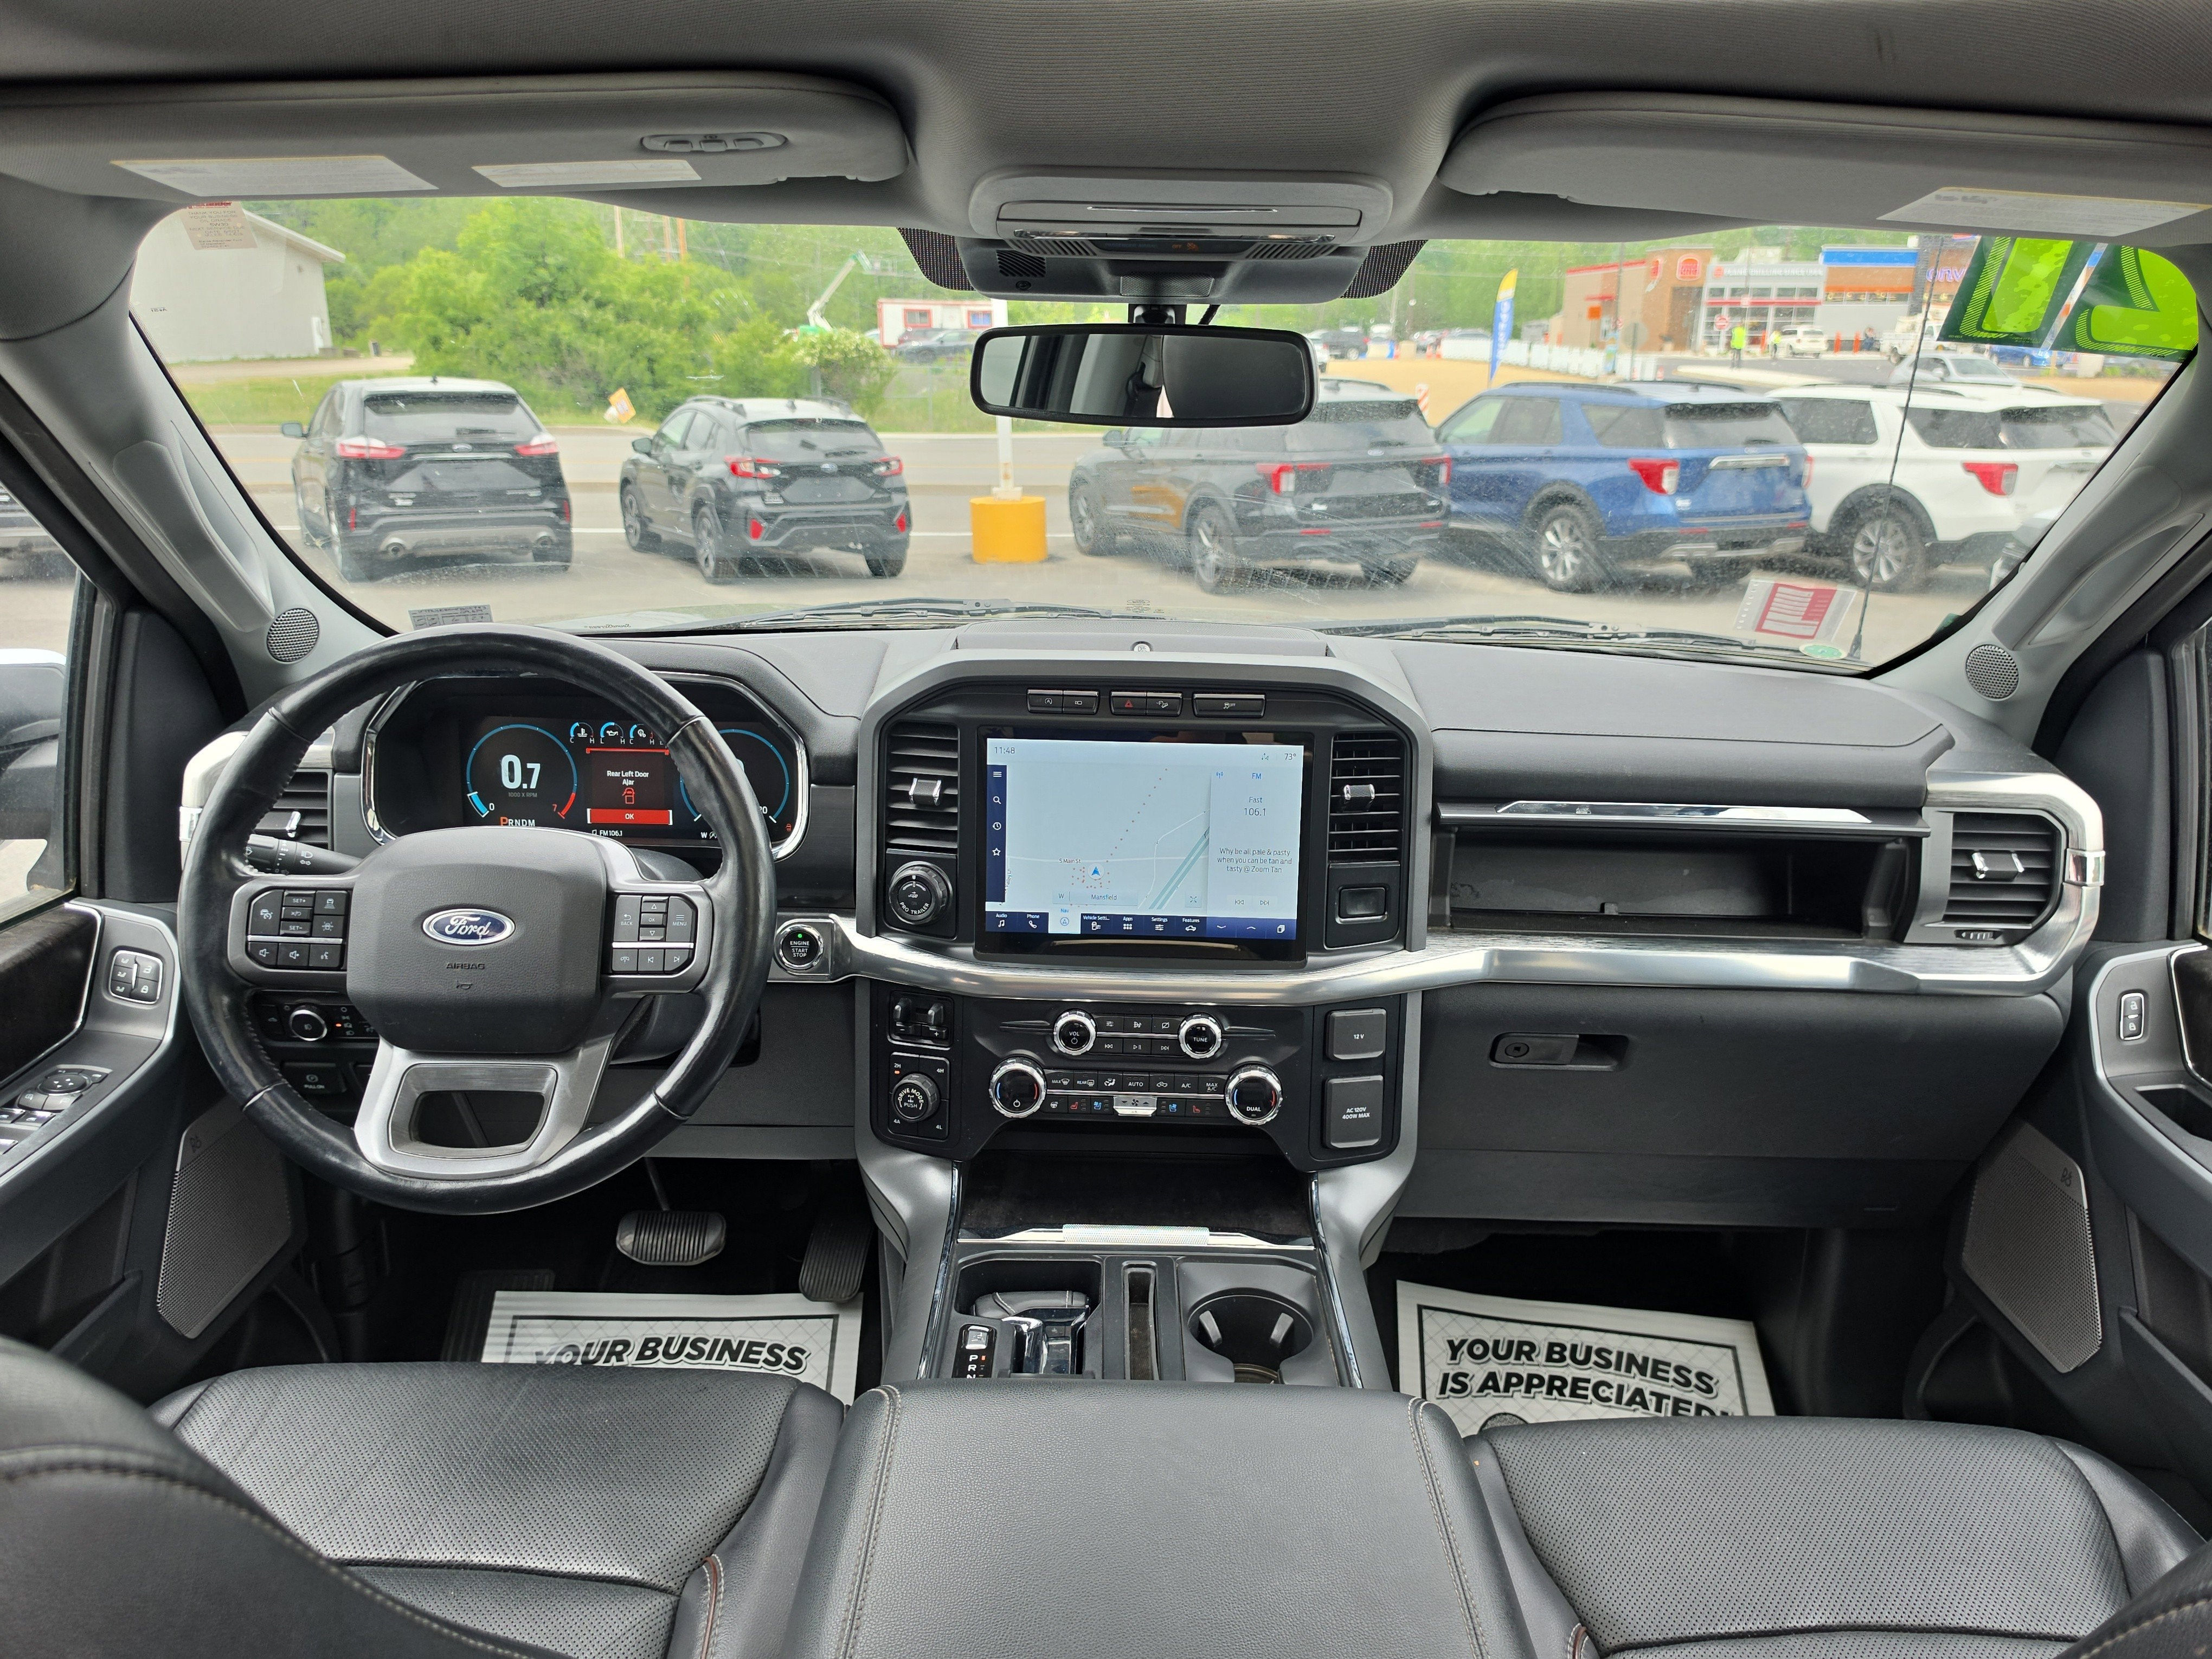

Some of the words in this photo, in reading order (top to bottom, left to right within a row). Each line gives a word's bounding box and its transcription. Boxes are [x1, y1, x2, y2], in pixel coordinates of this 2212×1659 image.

[501, 754, 541, 789] 0.7
[1244, 808, 1266, 816] 106.1
[899, 901, 909, 912] PRO
[911, 902, 930, 915] TRAILER
[445, 915, 491, 935] Ford
[898, 1088, 910, 1101] DRIVE
[911, 1088, 924, 1103] MODE
[635, 1336, 808, 1369] BUSINESS
[1446, 1339, 1539, 1362] YOUR
[1545, 1343, 1715, 1395] BUSINESS
[1439, 1372, 1470, 1395] IS
[1477, 1372, 1728, 1416] APPRECIATED
